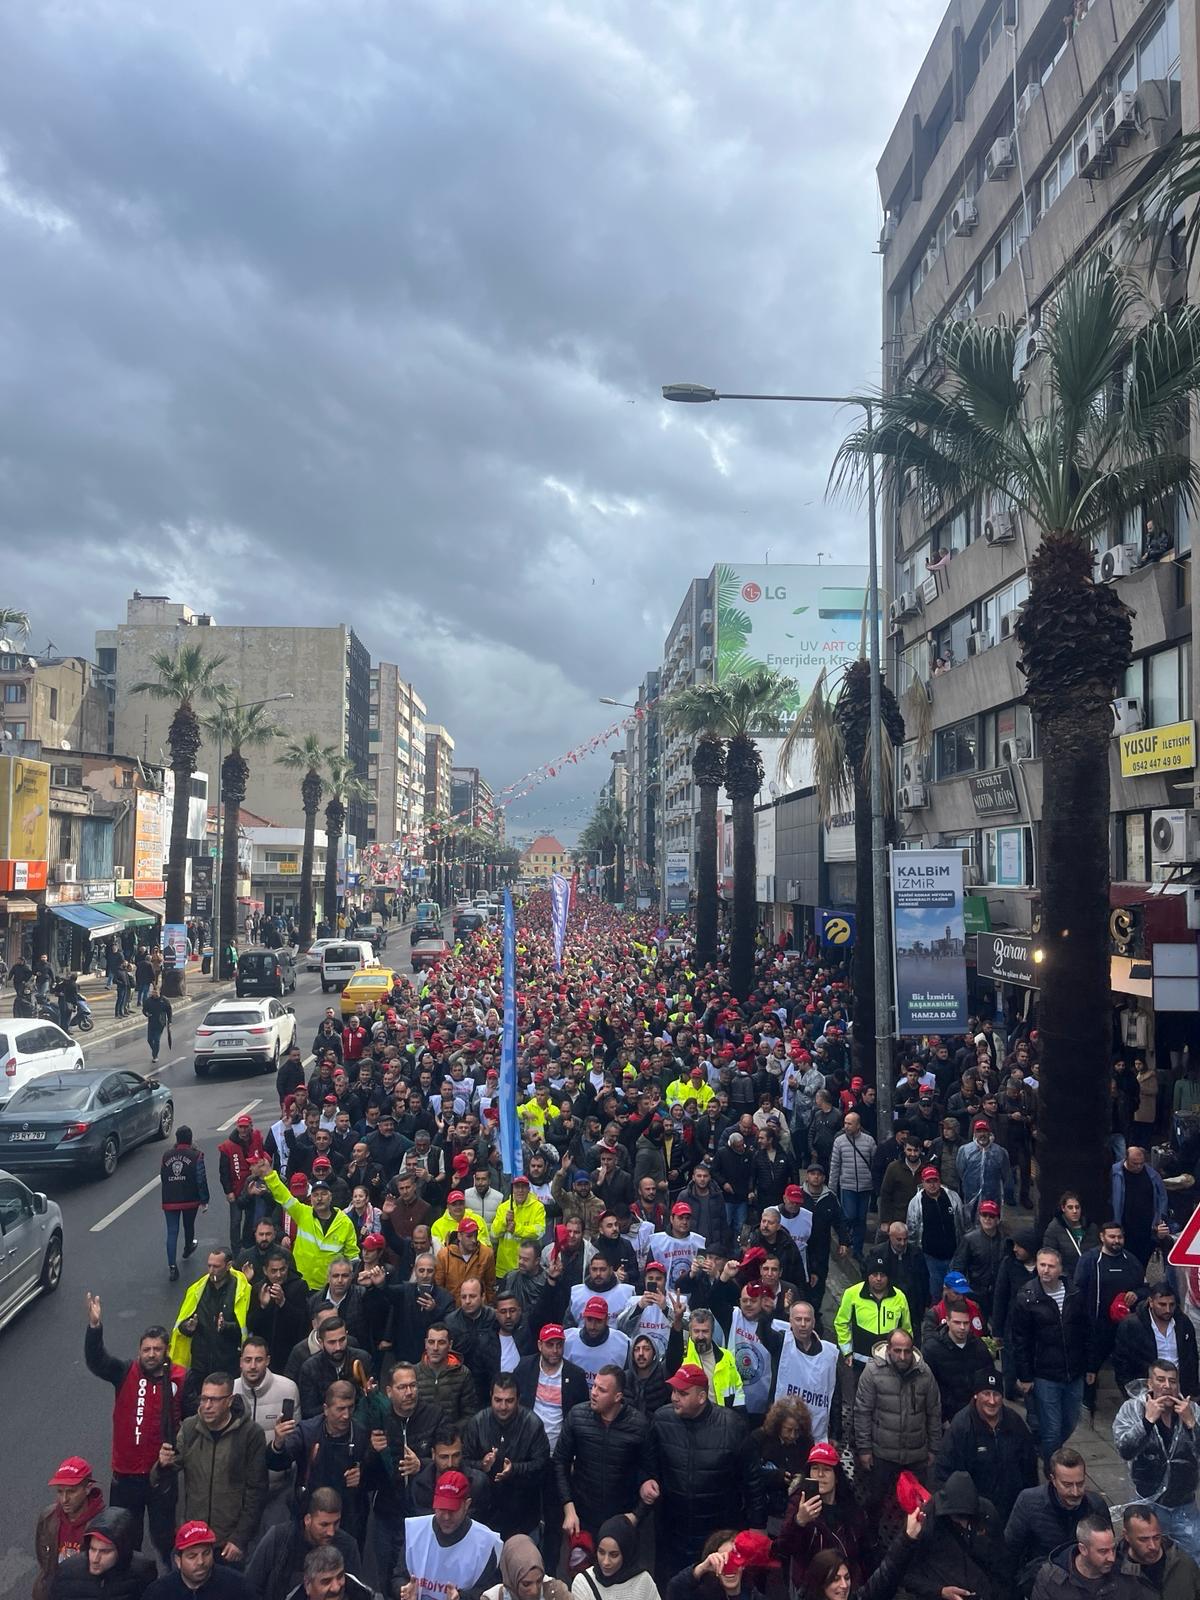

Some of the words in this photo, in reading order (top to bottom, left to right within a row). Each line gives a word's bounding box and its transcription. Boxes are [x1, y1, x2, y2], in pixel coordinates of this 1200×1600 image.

[765, 586, 787, 600] LG
[801, 641, 819, 651] UV
[822, 641, 845, 651] ART
[767, 654, 826, 668] Enerjiden
[1124, 735, 1158, 758] YUSUF
[1132, 760, 1148, 771] 0542
[1149, 758, 1161, 768] 447
[1162, 756, 1171, 766] 49
[1172, 754, 1182, 765] 09
[993, 937, 1027, 967] Baran
